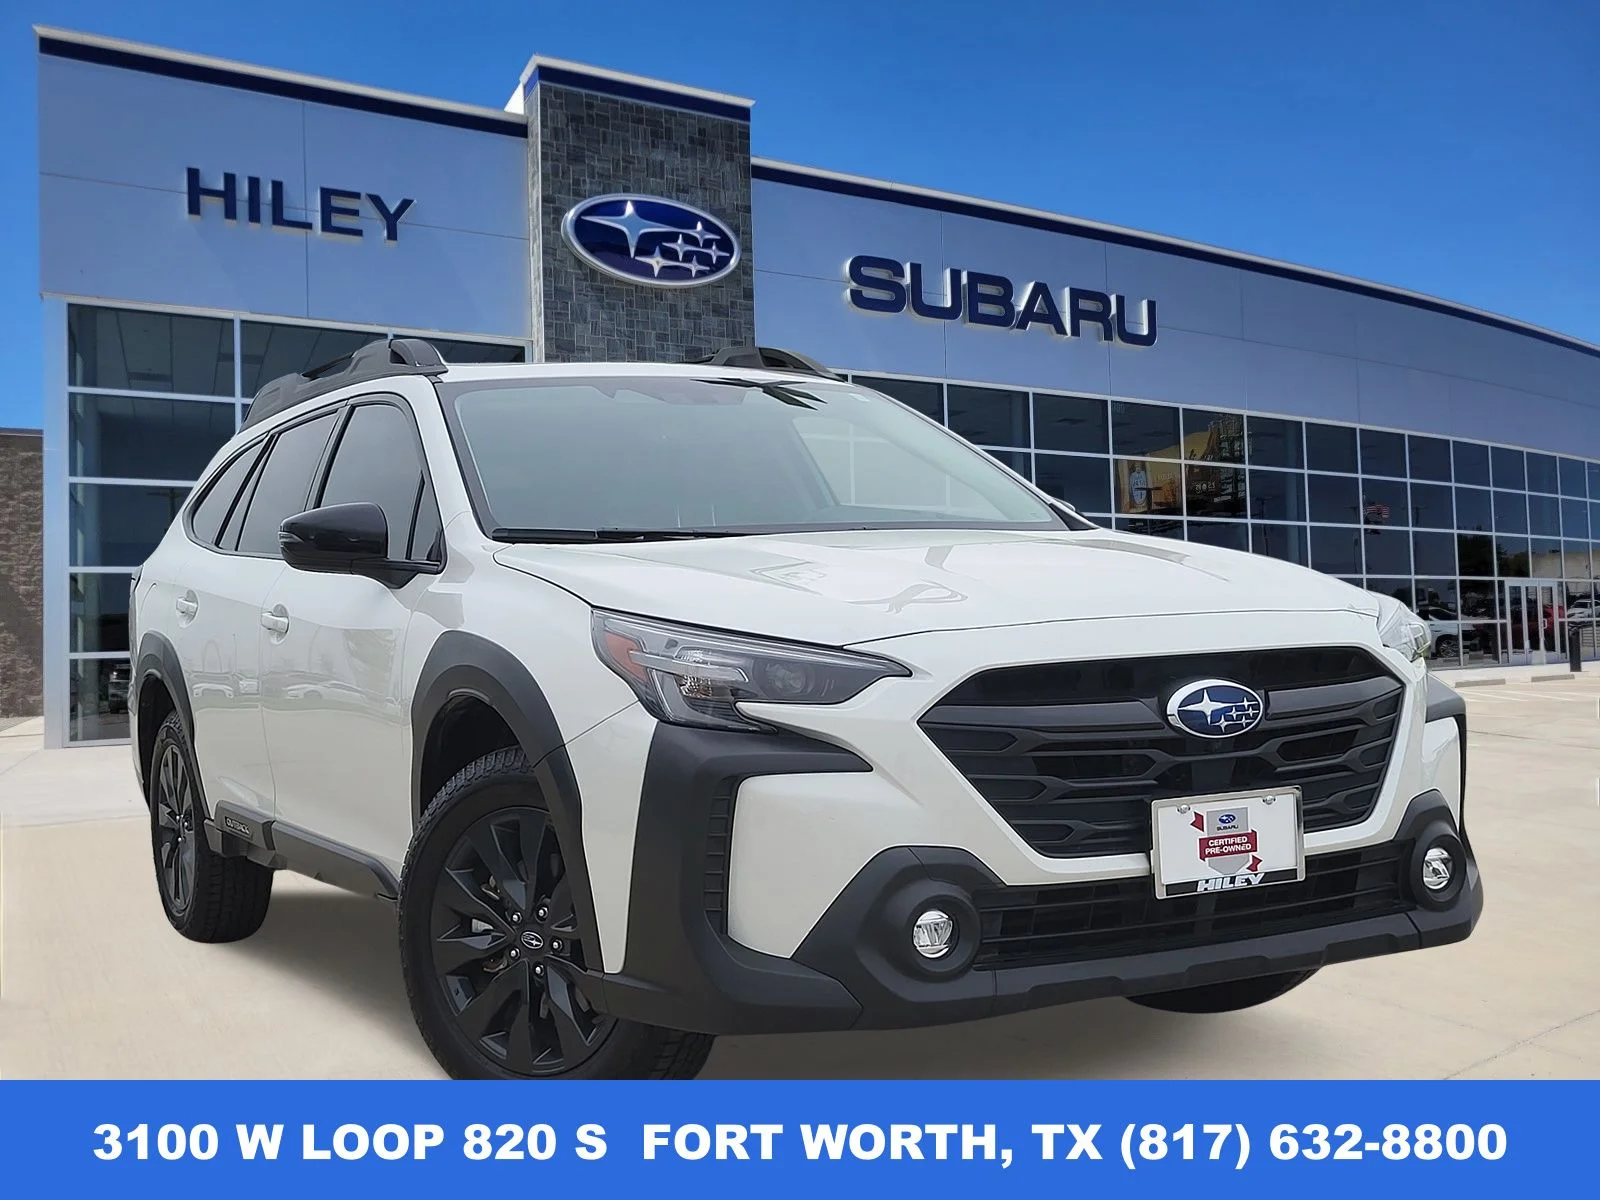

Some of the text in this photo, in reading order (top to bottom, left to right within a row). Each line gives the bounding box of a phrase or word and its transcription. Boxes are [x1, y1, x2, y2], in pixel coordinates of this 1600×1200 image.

[186, 167, 415, 241] HILEY
[846, 255, 1157, 347] SUBARU
[1205, 844, 1252, 855] PRE-OWNED
[1208, 836, 1248, 846] CERTIFIED
[1196, 872, 1265, 892] HILEY
